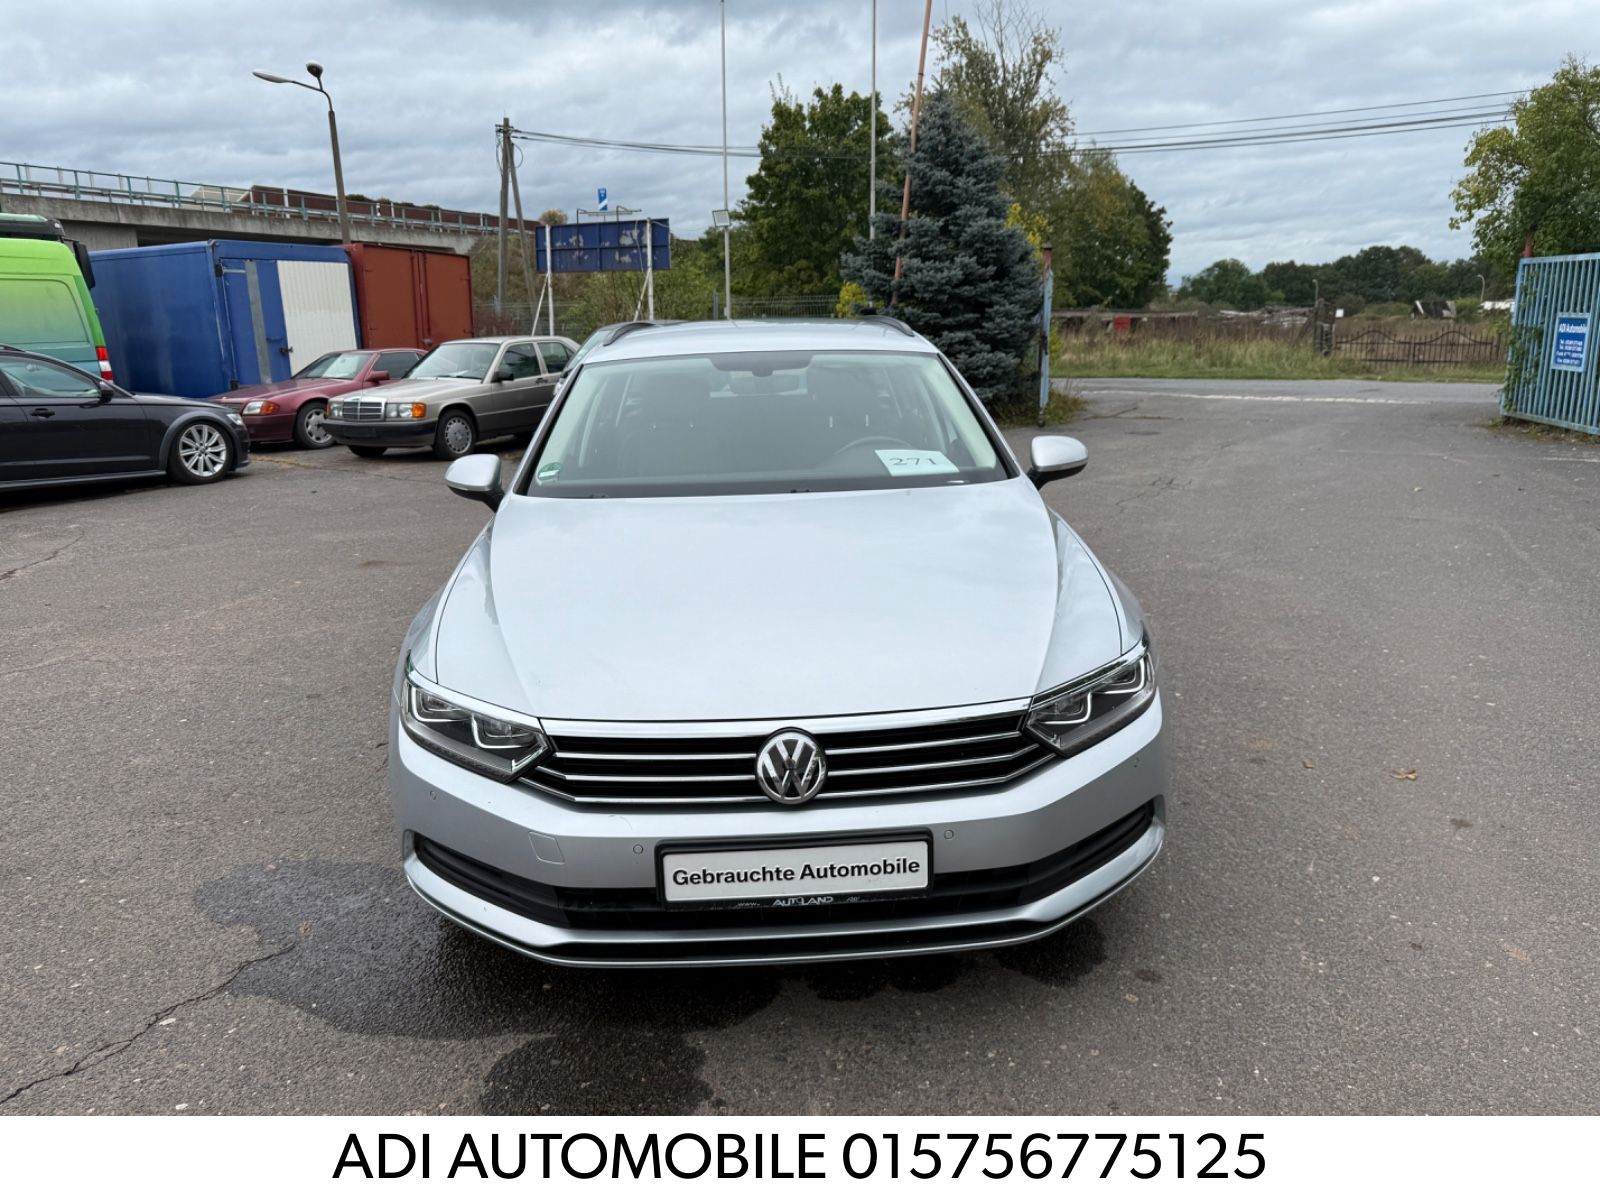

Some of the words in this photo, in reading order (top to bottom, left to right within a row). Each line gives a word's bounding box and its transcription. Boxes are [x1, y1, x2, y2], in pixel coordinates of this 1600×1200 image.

[889, 457, 936, 466] 271
[757, 731, 826, 804] VW
[672, 866, 795, 886] Gebrauchte
[799, 858, 921, 881] Automobile
